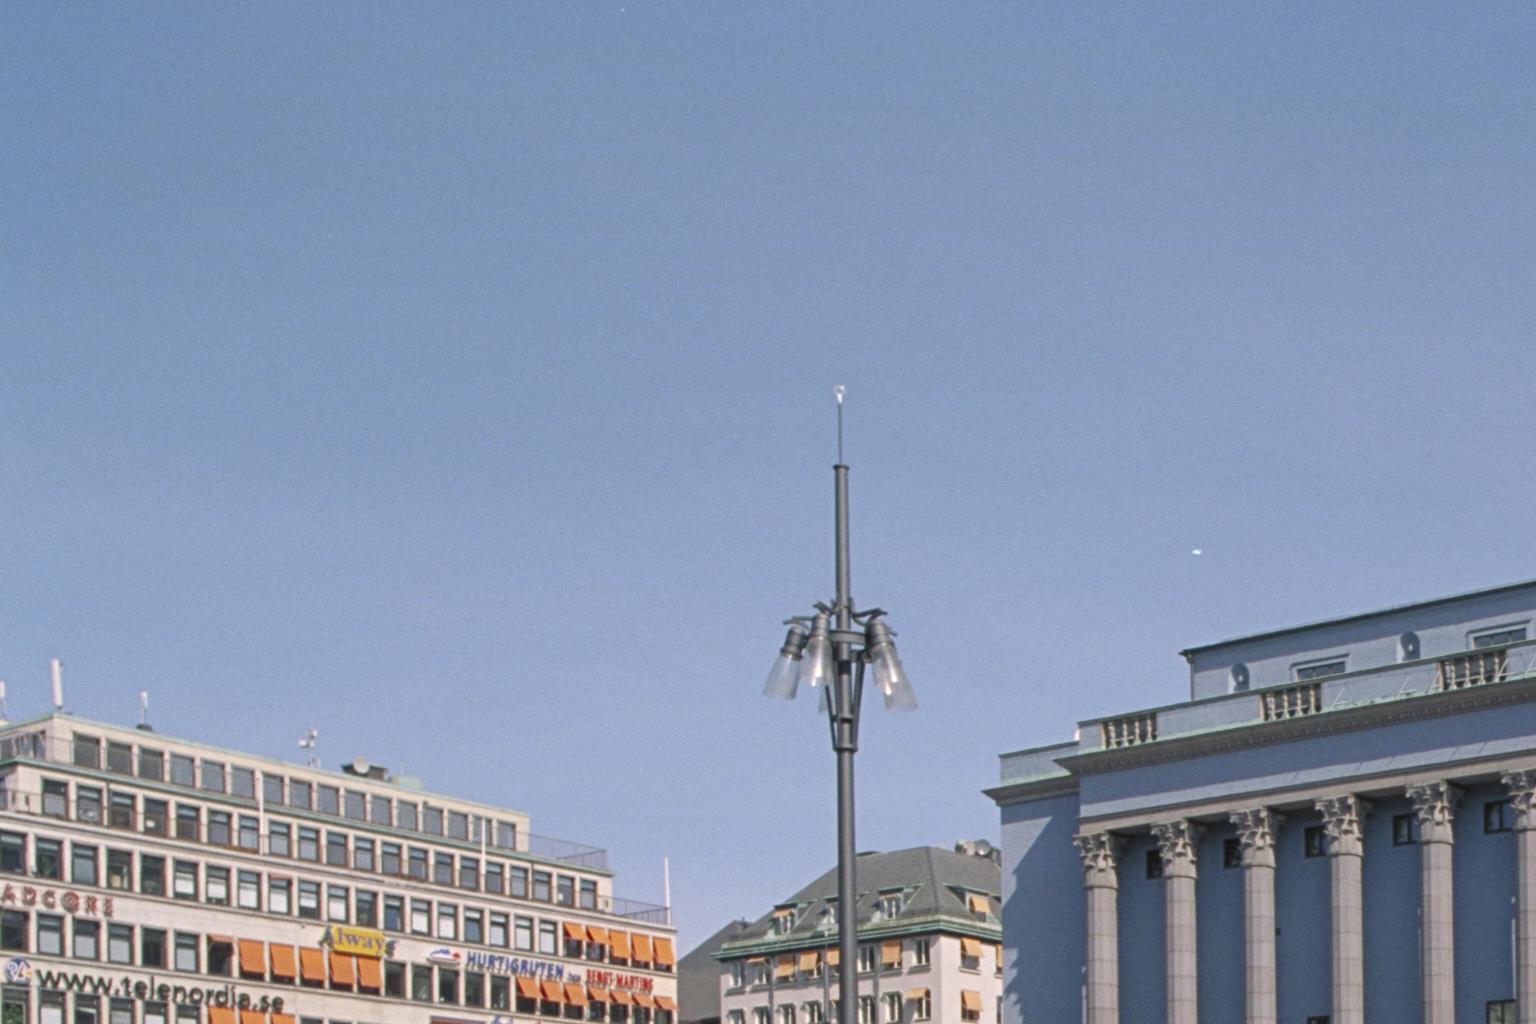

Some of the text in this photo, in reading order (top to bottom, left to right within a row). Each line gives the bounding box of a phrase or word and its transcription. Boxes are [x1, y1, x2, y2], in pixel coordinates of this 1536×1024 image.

[2, 883, 114, 918] ADCORE
[318, 926, 399, 958] Always
[467, 951, 564, 979] HURTIGRUTEN
[37, 969, 285, 1013] www.telenordia.se
